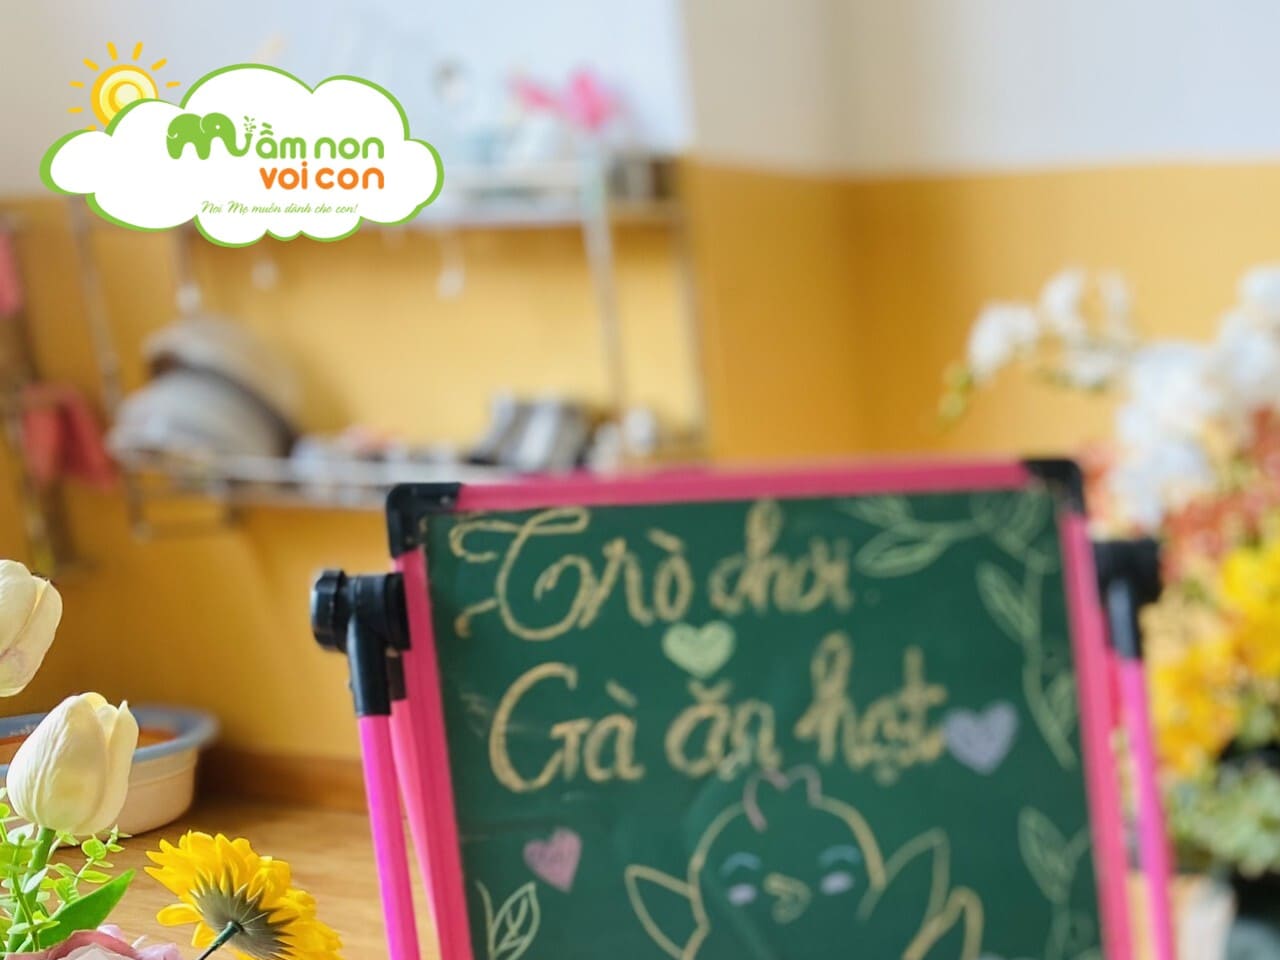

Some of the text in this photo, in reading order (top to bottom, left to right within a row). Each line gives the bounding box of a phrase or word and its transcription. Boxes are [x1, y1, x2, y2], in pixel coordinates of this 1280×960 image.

[449, 496, 854, 641] Trò chơi
[488, 631, 950, 793] Gà ăn hạt
